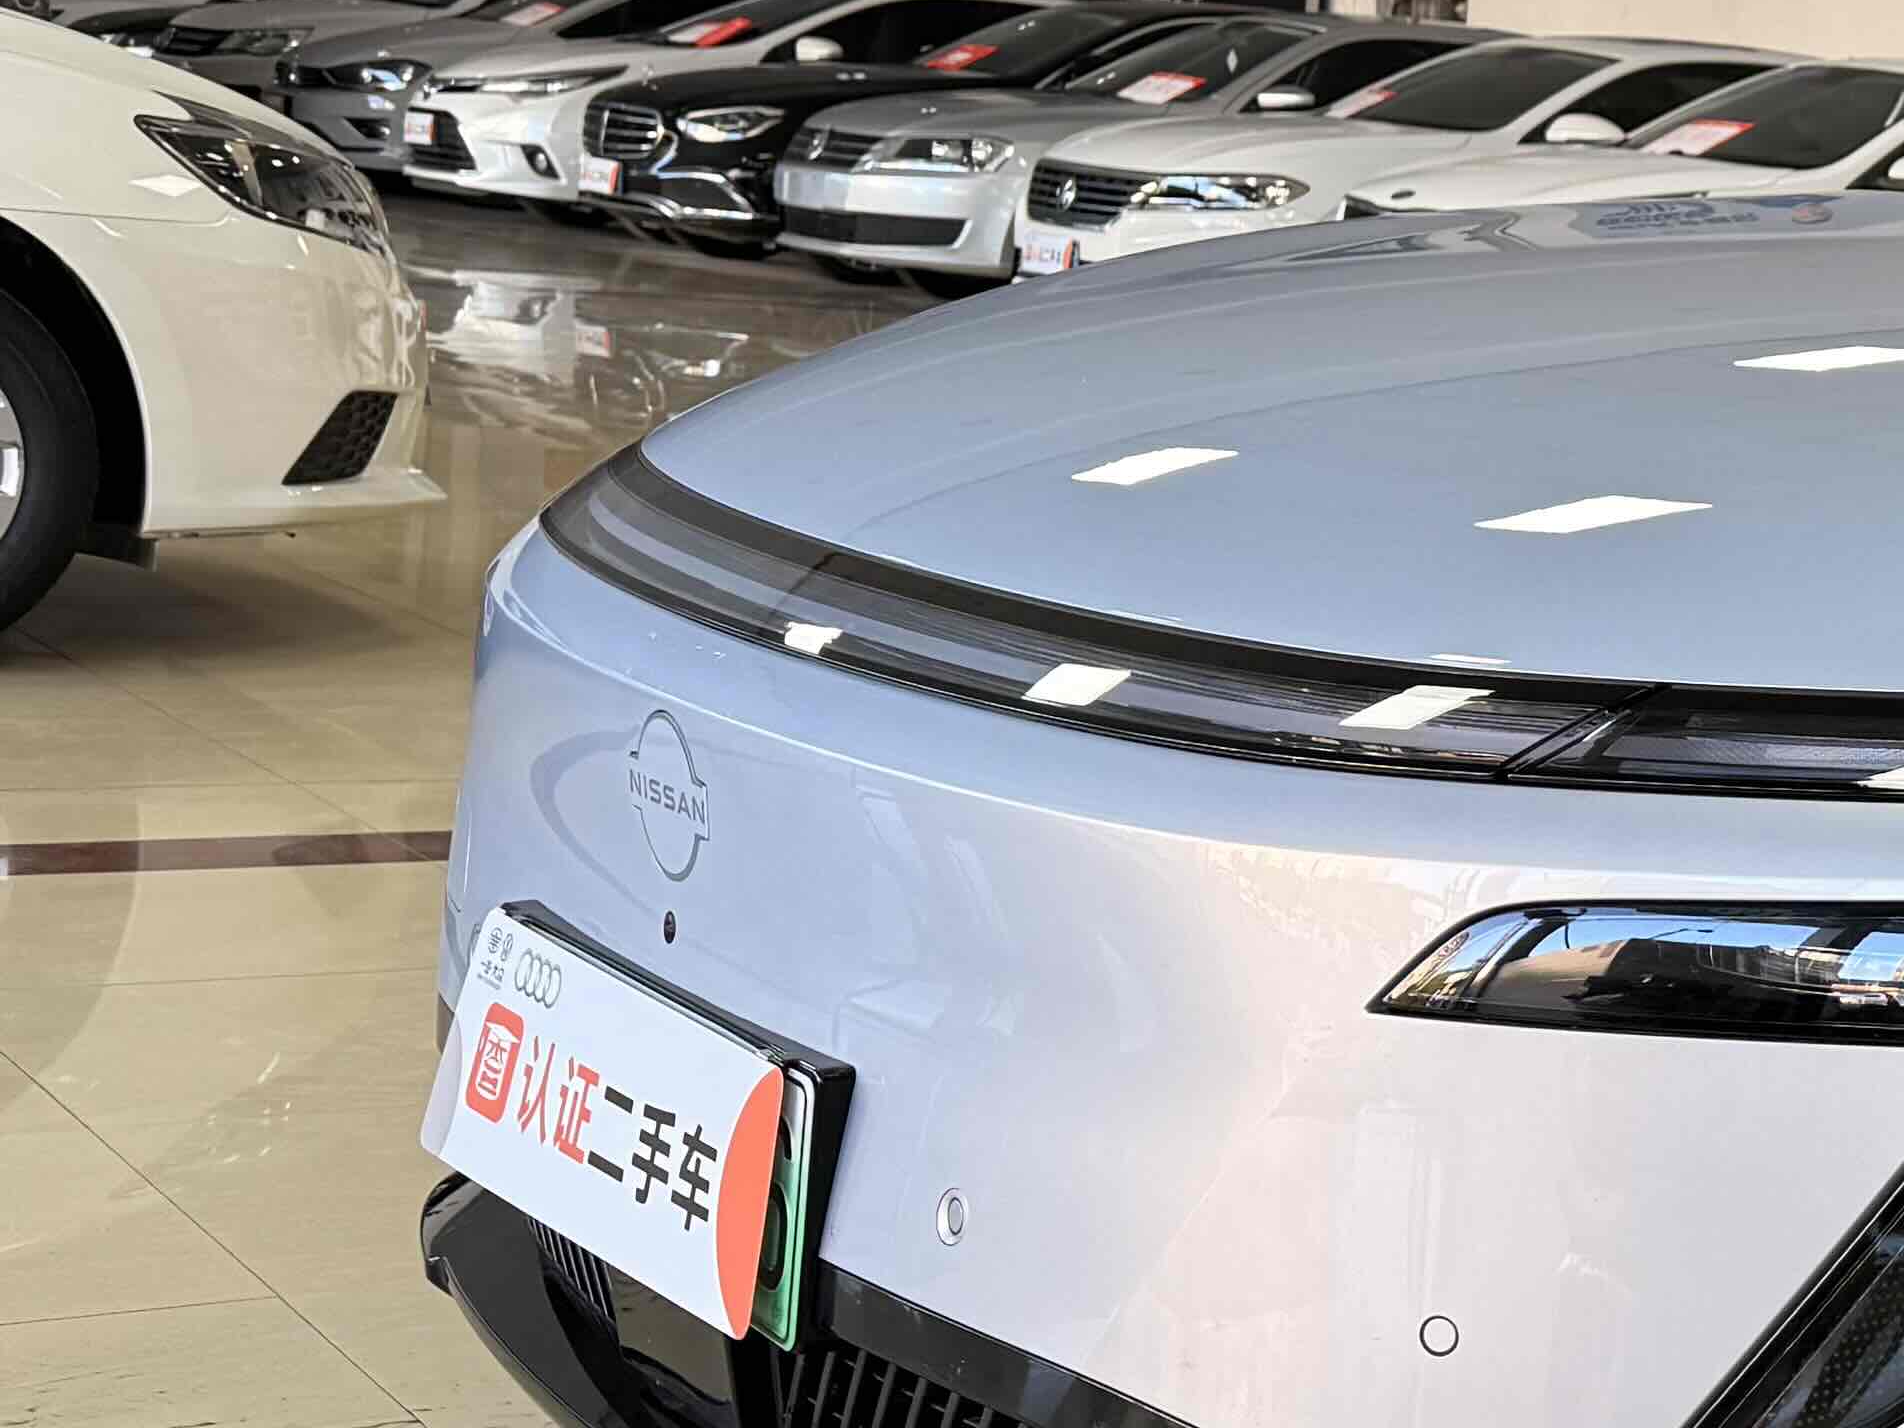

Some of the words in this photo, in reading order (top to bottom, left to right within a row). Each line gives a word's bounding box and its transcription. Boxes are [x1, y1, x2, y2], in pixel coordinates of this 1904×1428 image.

[627, 768, 707, 824] NISSAN
[515, 1033, 719, 1232] 认证二手车
